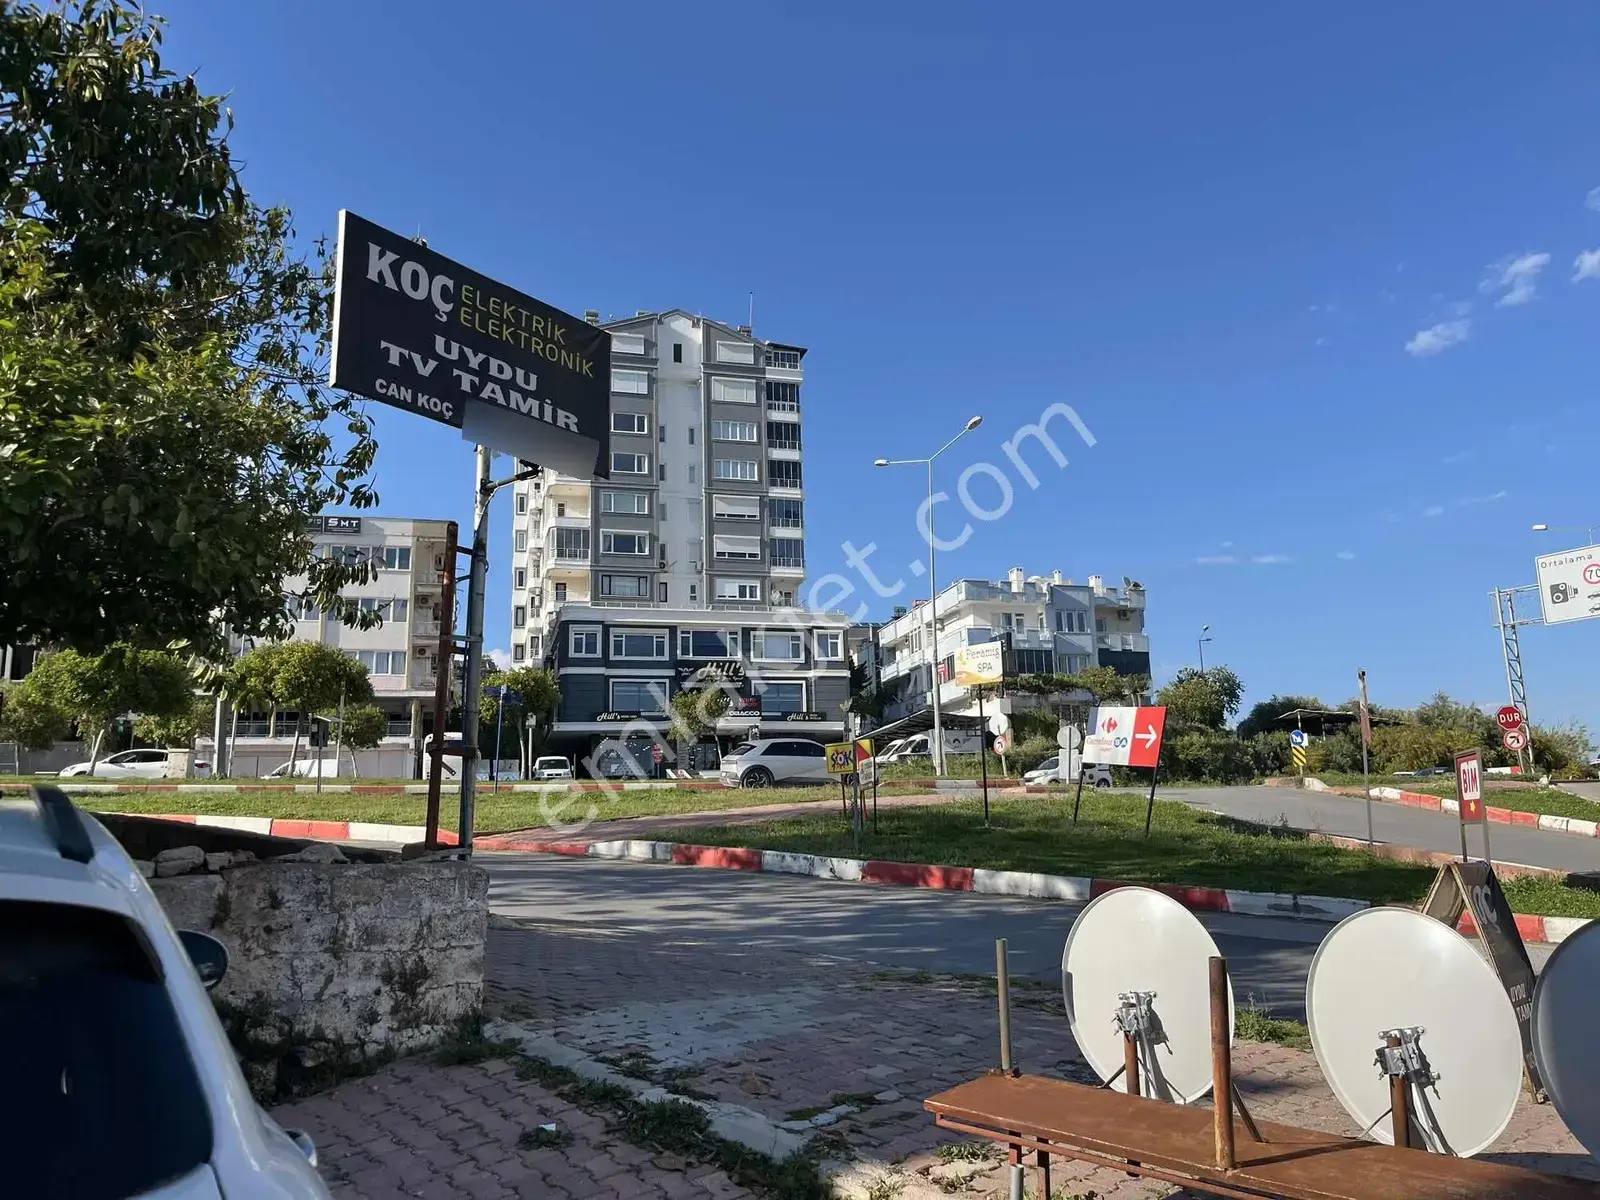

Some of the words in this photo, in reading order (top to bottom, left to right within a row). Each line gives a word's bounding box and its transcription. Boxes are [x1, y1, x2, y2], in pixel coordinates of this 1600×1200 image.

[366, 242, 454, 322] KOÇ
[461, 284, 566, 345] ELEKTRİK
[460, 310, 595, 378] ELEKTRONİK
[434, 334, 538, 391] UYDU
[380, 340, 439, 378] TV
[453, 369, 579, 433] TAMİR
[375, 378, 412, 403] CAN
[417, 392, 454, 420] KOÇ
[328, 518, 359, 527] SMT
[1541, 554, 1593, 569] Ortalama
[697, 662, 745, 680] Hill's
[977, 662, 993, 672] SPA
[596, 712, 621, 722] Hill's
[787, 712, 809, 721] Hill's
[1500, 713, 1520, 723] DUR
